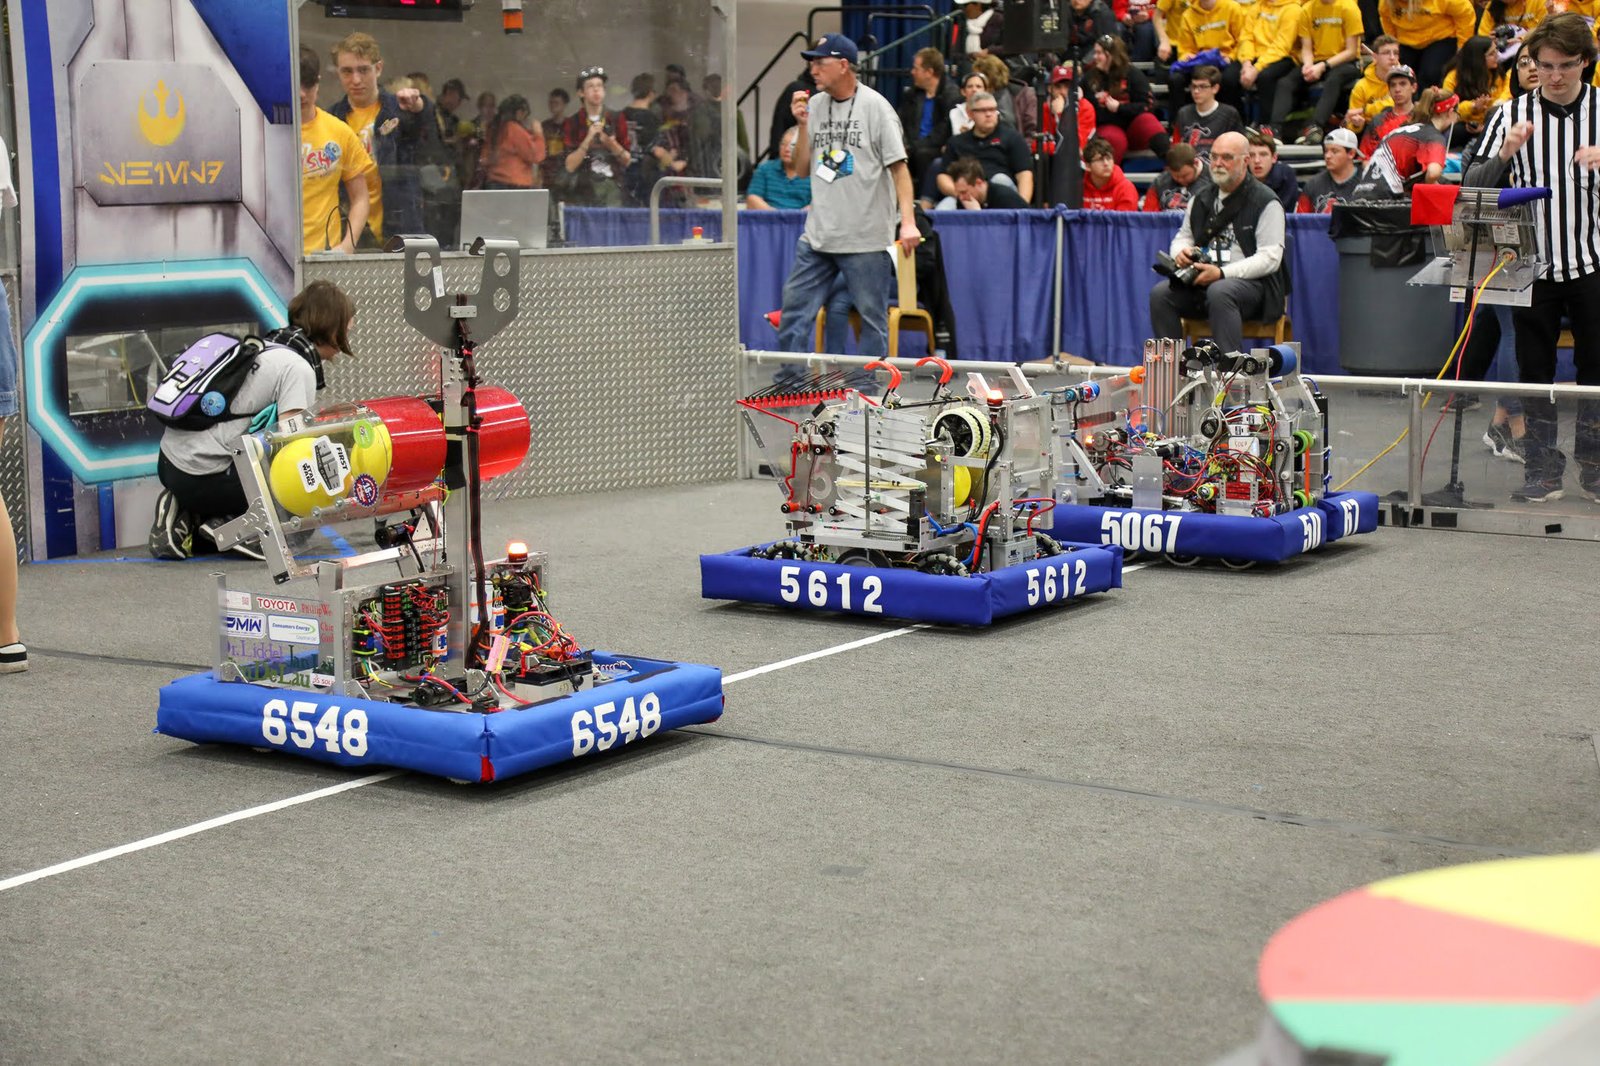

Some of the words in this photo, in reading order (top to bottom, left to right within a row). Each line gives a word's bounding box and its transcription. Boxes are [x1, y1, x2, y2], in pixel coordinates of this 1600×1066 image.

[336, 447, 348, 471] FIRST
[1101, 511, 1183, 553] 5067
[1298, 512, 1321, 553] 50
[1340, 498, 1359, 537] 67
[780, 565, 883, 613] 5612
[1025, 559, 1087, 606] 5612
[257, 597, 298, 613] TOYOTA
[271, 622, 296, 630] Consumers
[295, 624, 311, 632] Energy
[262, 698, 369, 757] 6548
[571, 691, 662, 758] 6548
